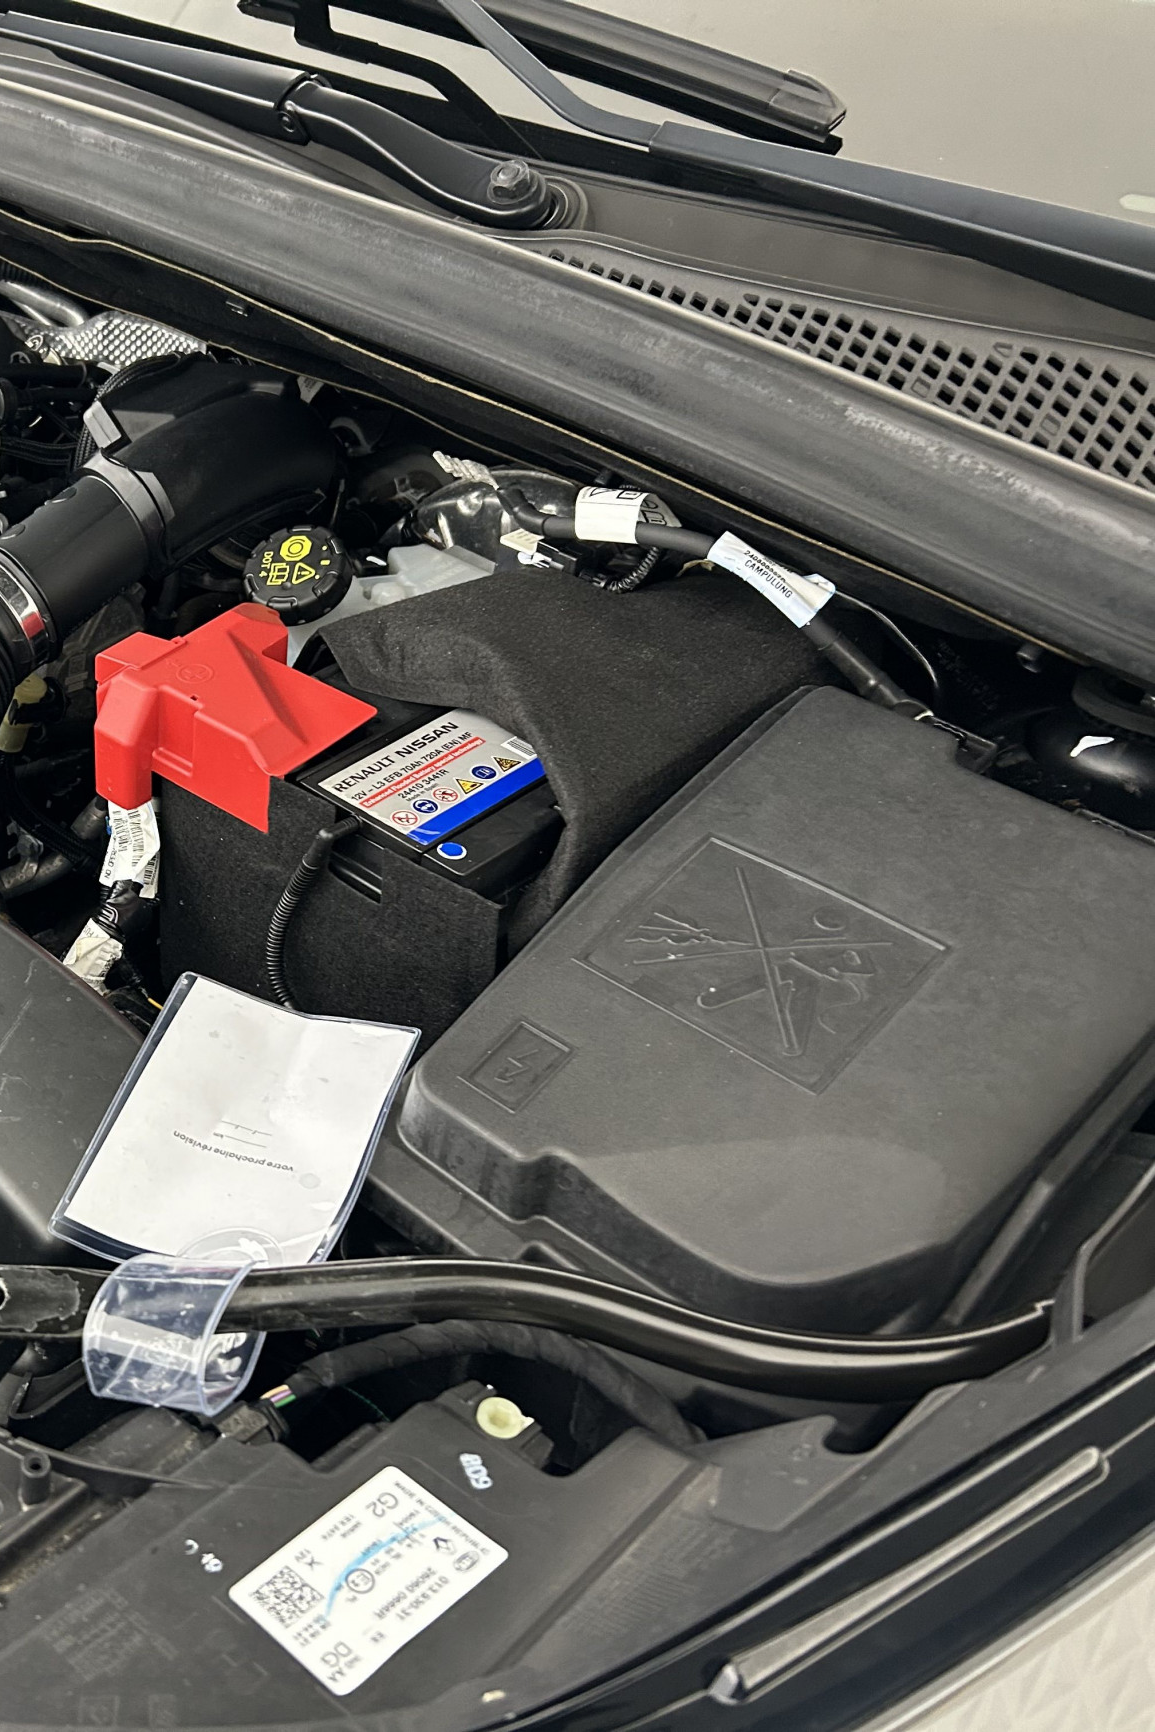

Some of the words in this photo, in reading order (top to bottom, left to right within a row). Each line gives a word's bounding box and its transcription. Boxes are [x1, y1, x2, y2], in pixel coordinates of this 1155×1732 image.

[261, 551, 274, 569] DOT
[744, 559, 793, 598] CAMPULUNG
[332, 755, 395, 793] RENAULT
[394, 721, 459, 758] NISSAN
[351, 790, 367, 801] 12V
[372, 780, 386, 790] L3
[383, 771, 403, 784] EFB
[400, 760, 424, 773] 70Ah
[421, 749, 444, 762] 720A
[441, 739, 462, 754] (EN)
[458, 731, 473, 741] MF
[363, 786, 392, 805] Enhanced
[393, 776, 413, 791] Flooded
[413, 765, 435, 780] Battery
[434, 754, 454, 769] special
[453, 738, 484, 757] technology
[398, 782, 423, 799] 24410
[422, 768, 450, 785] 3441R
[173, 1130, 213, 1151] révision
[214, 1147, 266, 1166] prochaine
[266, 1161, 293, 1172] votre
[366, 1491, 398, 1518] G2
[320, 1641, 352, 1668] DG
